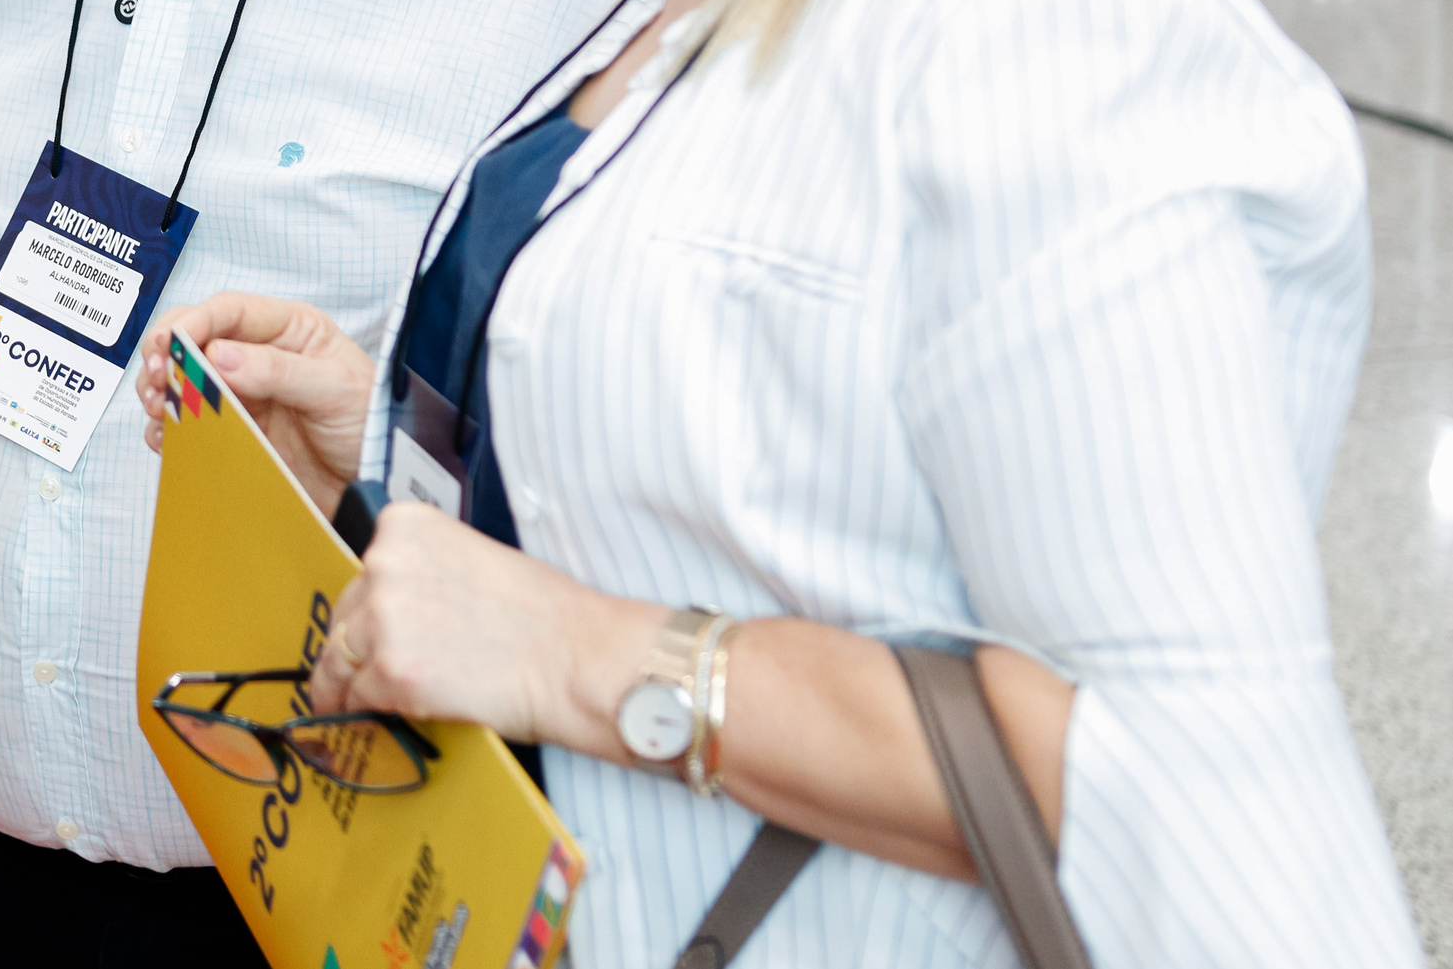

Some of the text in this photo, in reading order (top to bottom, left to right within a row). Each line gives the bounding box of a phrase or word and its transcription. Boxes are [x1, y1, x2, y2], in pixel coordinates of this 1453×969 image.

[45, 200, 142, 264] PARTICIPANTE
[48, 234, 70, 248] MARCELO
[70, 244, 97, 263] RODRIGUES
[28, 238, 124, 294] MARCELO RODRIGUES
[49, 270, 90, 296] ALHANDRA
[8, 341, 96, 394] CONFEP
[20, 426, 40, 440] CAIXA
